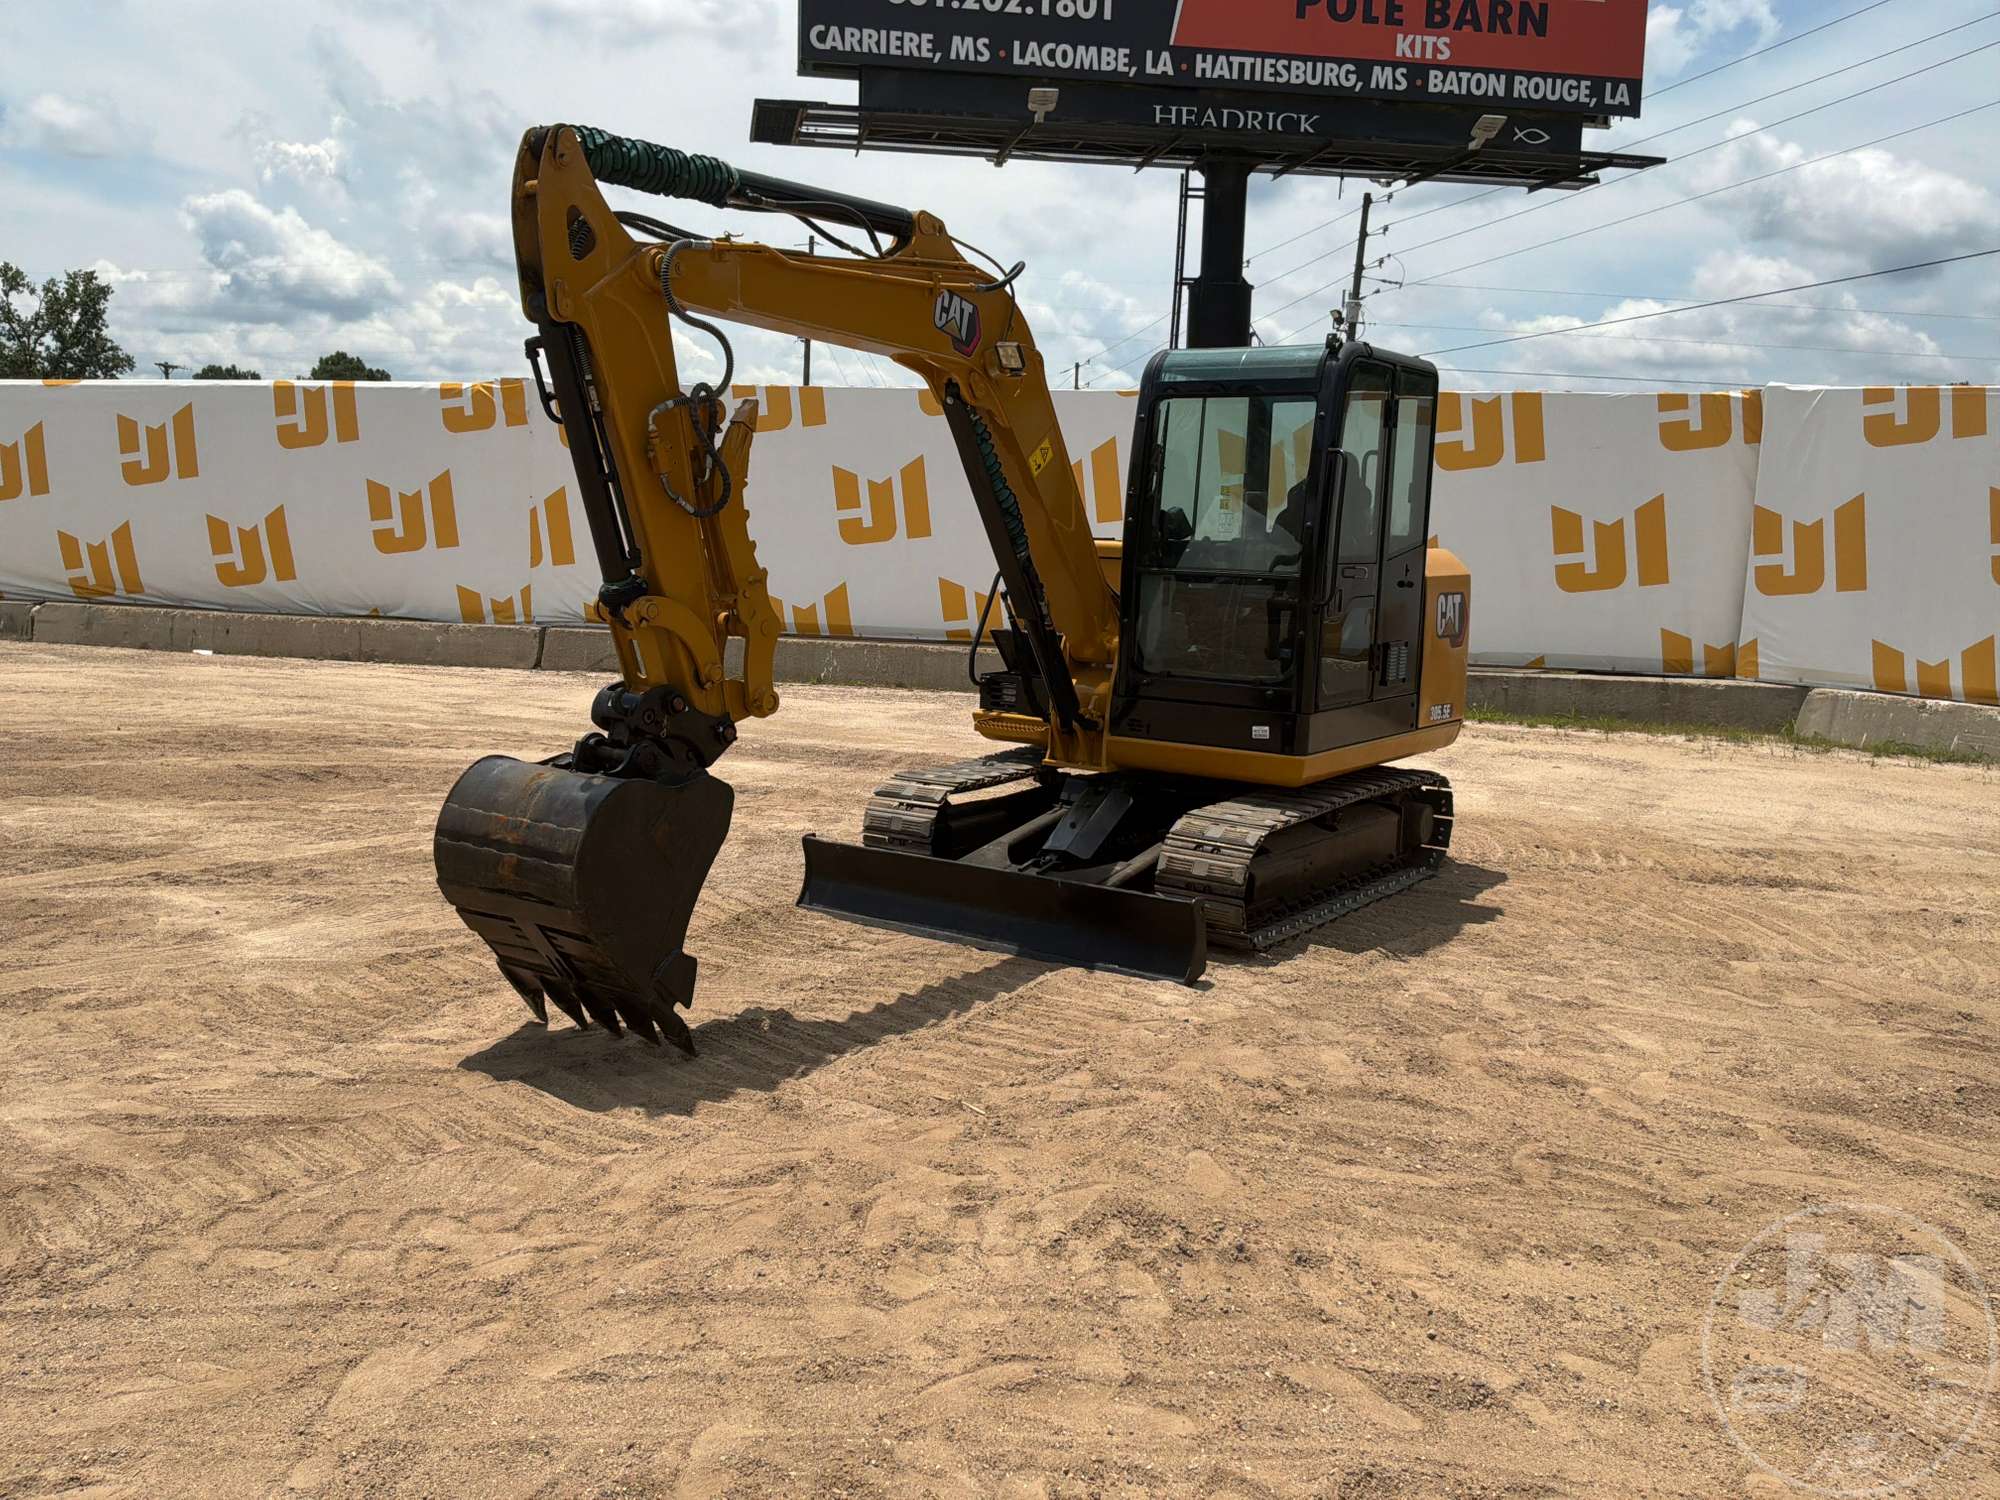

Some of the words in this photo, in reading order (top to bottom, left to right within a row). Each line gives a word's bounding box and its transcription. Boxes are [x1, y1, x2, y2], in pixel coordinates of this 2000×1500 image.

[1296, 0, 1404, 26] POLE
[1425, 0, 1549, 37] BARN
[809, 24, 942, 64] CARRIERE,
[950, 35, 991, 63] MS
[1013, 40, 1138, 77] LACOMBE,
[1145, 50, 1175, 76] LA
[1195, 53, 1363, 92] HATTIESBURG,
[1370, 65, 1408, 91] MS
[1427, 69, 1506, 98] BATON
[1512, 75, 1597, 107] ROUGE,
[1604, 81, 1631, 106] LA
[1395, 33, 1451, 60] KITS
[1153, 104, 1320, 133] HEADRICK
[934, 289, 974, 341] CAT
[1437, 593, 1462, 636] CAT
